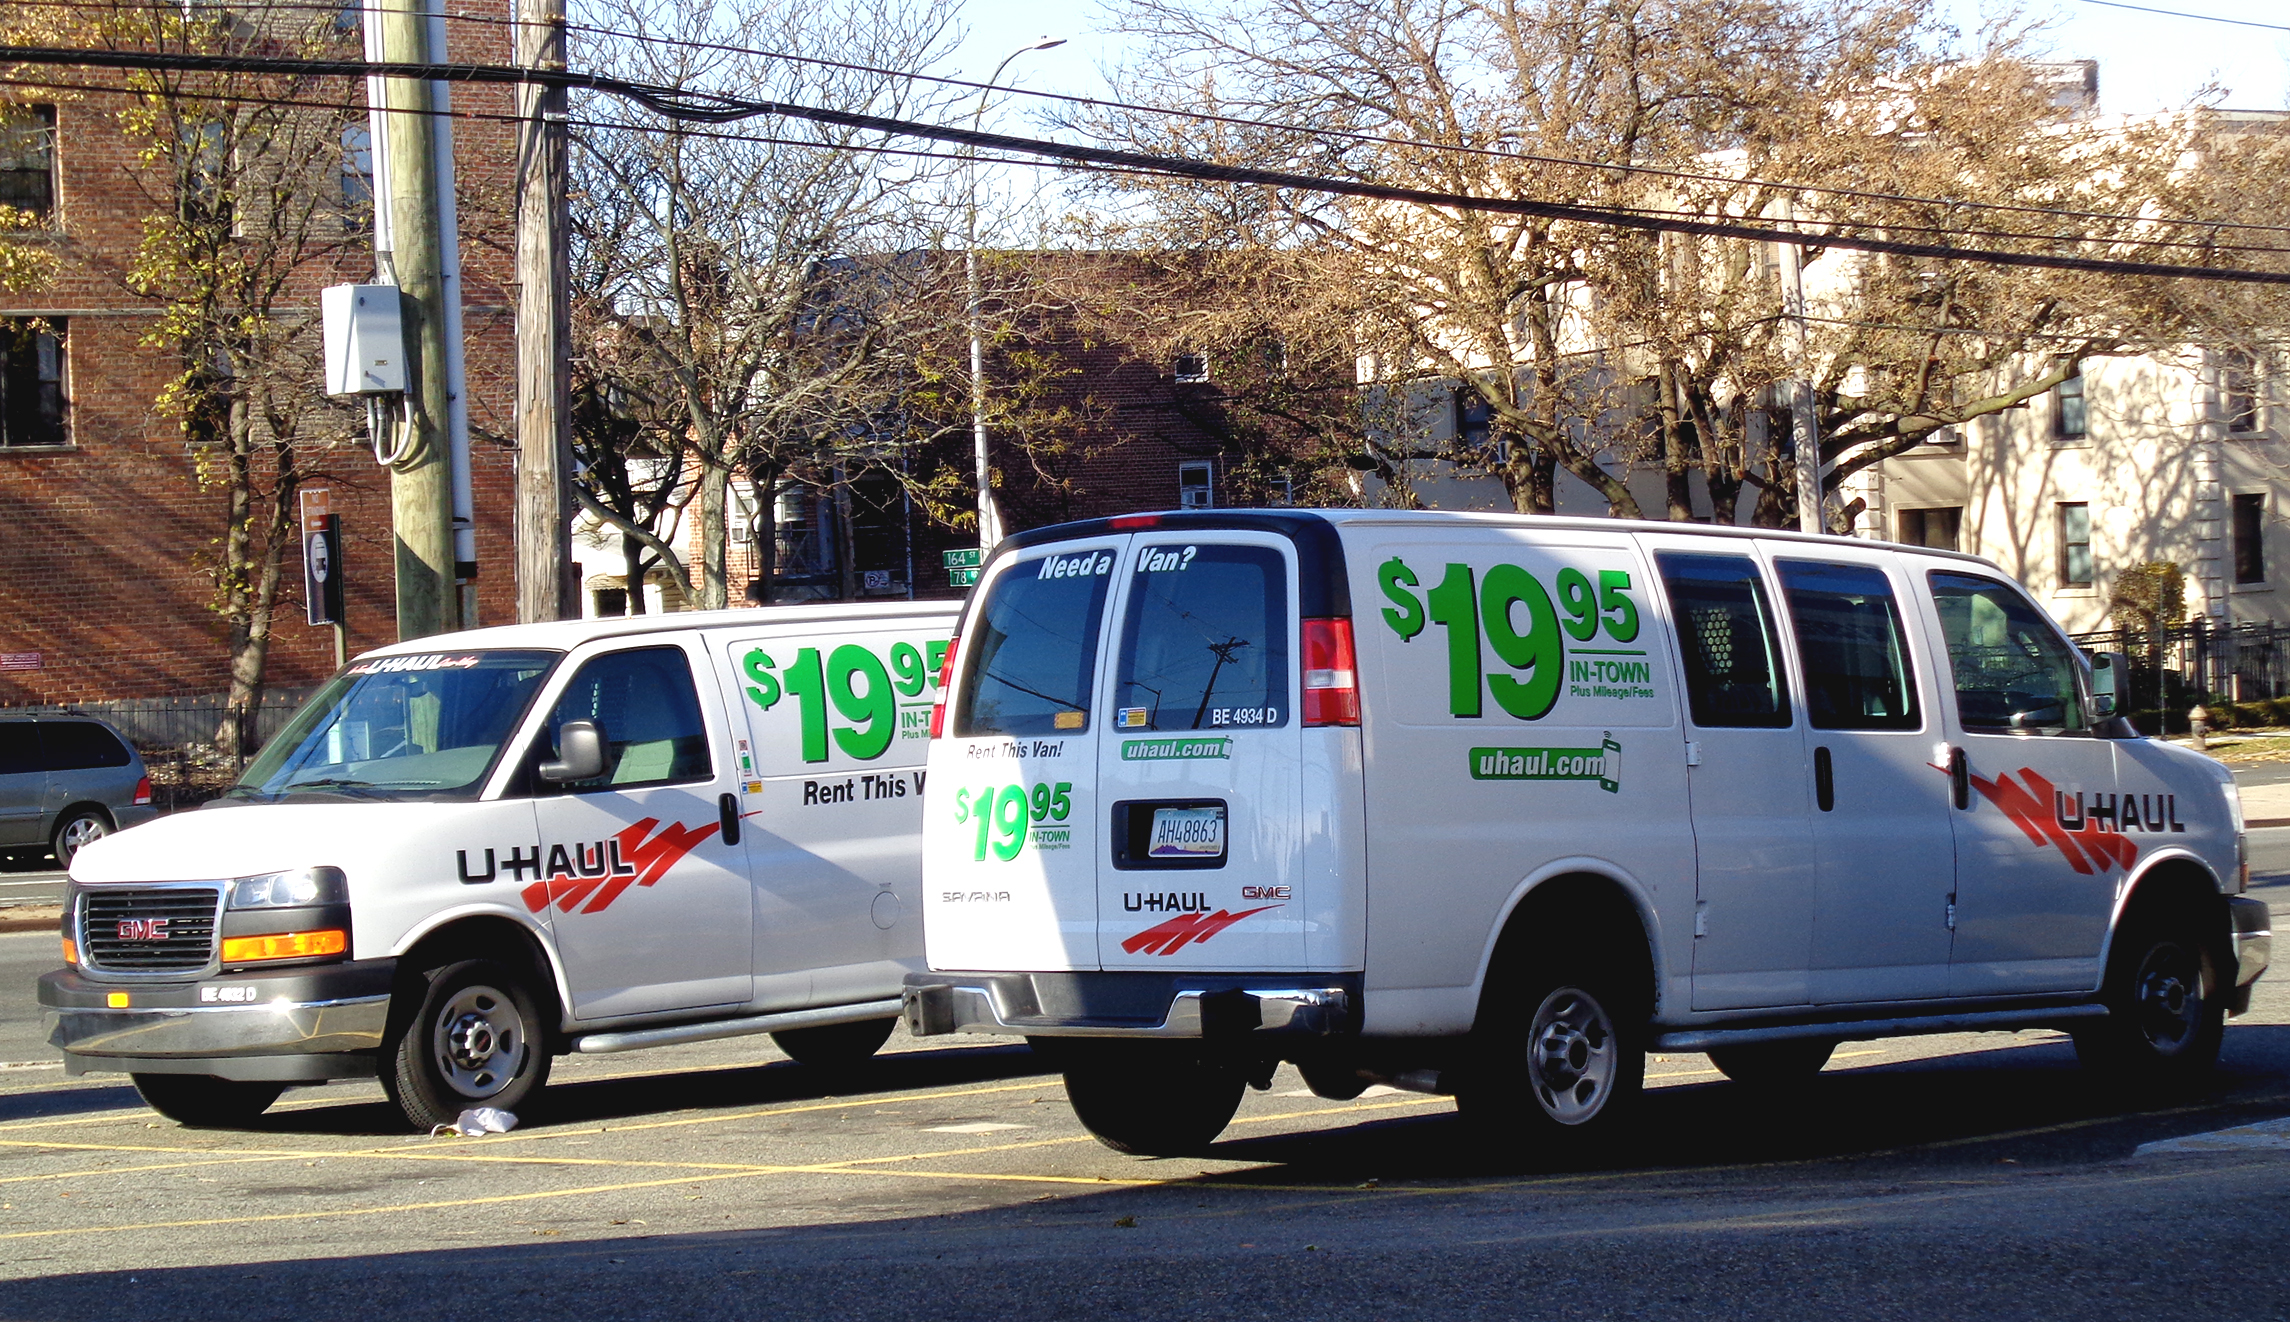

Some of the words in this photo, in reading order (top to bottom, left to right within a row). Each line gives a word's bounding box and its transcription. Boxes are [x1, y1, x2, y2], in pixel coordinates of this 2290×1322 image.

[947, 552, 966, 566] 164
[969, 551, 976, 559] ST
[1037, 552, 1098, 580] Need
[1095, 556, 1111, 575] a
[1137, 546, 1196, 573] Van?
[954, 571, 967, 584] 78
[364, 655, 444, 675] U-HAUL
[1569, 661, 1650, 684] IN-TOWN
[1570, 685, 1591, 698] Plus
[1593, 685, 1654, 700] Mileage/Fees
[901, 710, 932, 729] IN-T
[1212, 708, 1230, 725] BE
[1233, 708, 1263, 725] 4934
[1266, 707, 1278, 724] D
[967, 744, 996, 759] Rent
[1001, 742, 1027, 759] This
[1032, 741, 1064, 758] Van!
[1127, 741, 1220, 759] uhaul.com
[1479, 750, 1606, 777] uhaul.com
[803, 779, 854, 806] Rent
[861, 774, 906, 800] This
[2055, 791, 2185, 832] U-HAUL
[1029, 830, 1070, 843] IN-TOWN
[1157, 820, 1218, 844] AH48863
[456, 838, 636, 886] U-HAUL
[942, 891, 1011, 902] SAVANA
[1124, 892, 1212, 912] U-HAUL
[1242, 886, 1291, 900] GMC
[117, 919, 169, 940] GMC
[246, 986, 257, 1002] D
